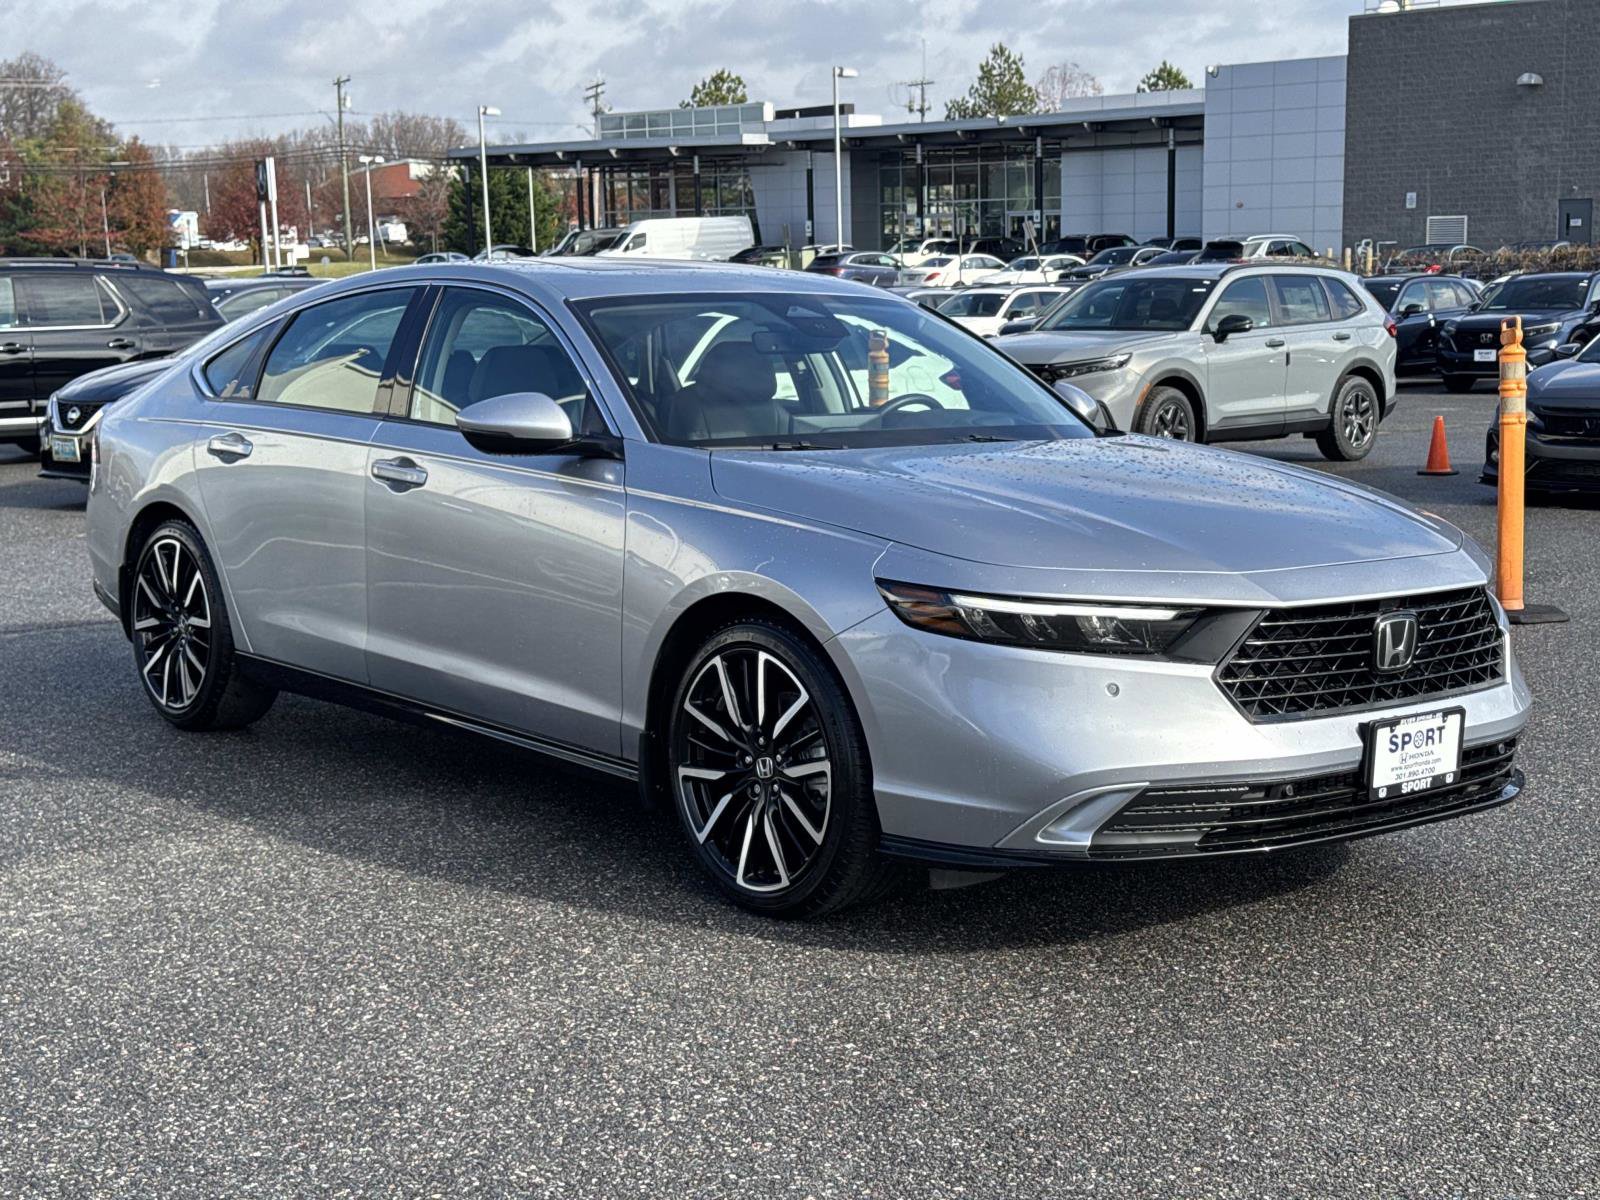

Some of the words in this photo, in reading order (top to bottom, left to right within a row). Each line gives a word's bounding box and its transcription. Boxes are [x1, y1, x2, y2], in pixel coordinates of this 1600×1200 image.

[1389, 725, 1446, 753] SPORT
[1408, 750, 1434, 760] HONDA
[1401, 777, 1433, 794] SPORT
